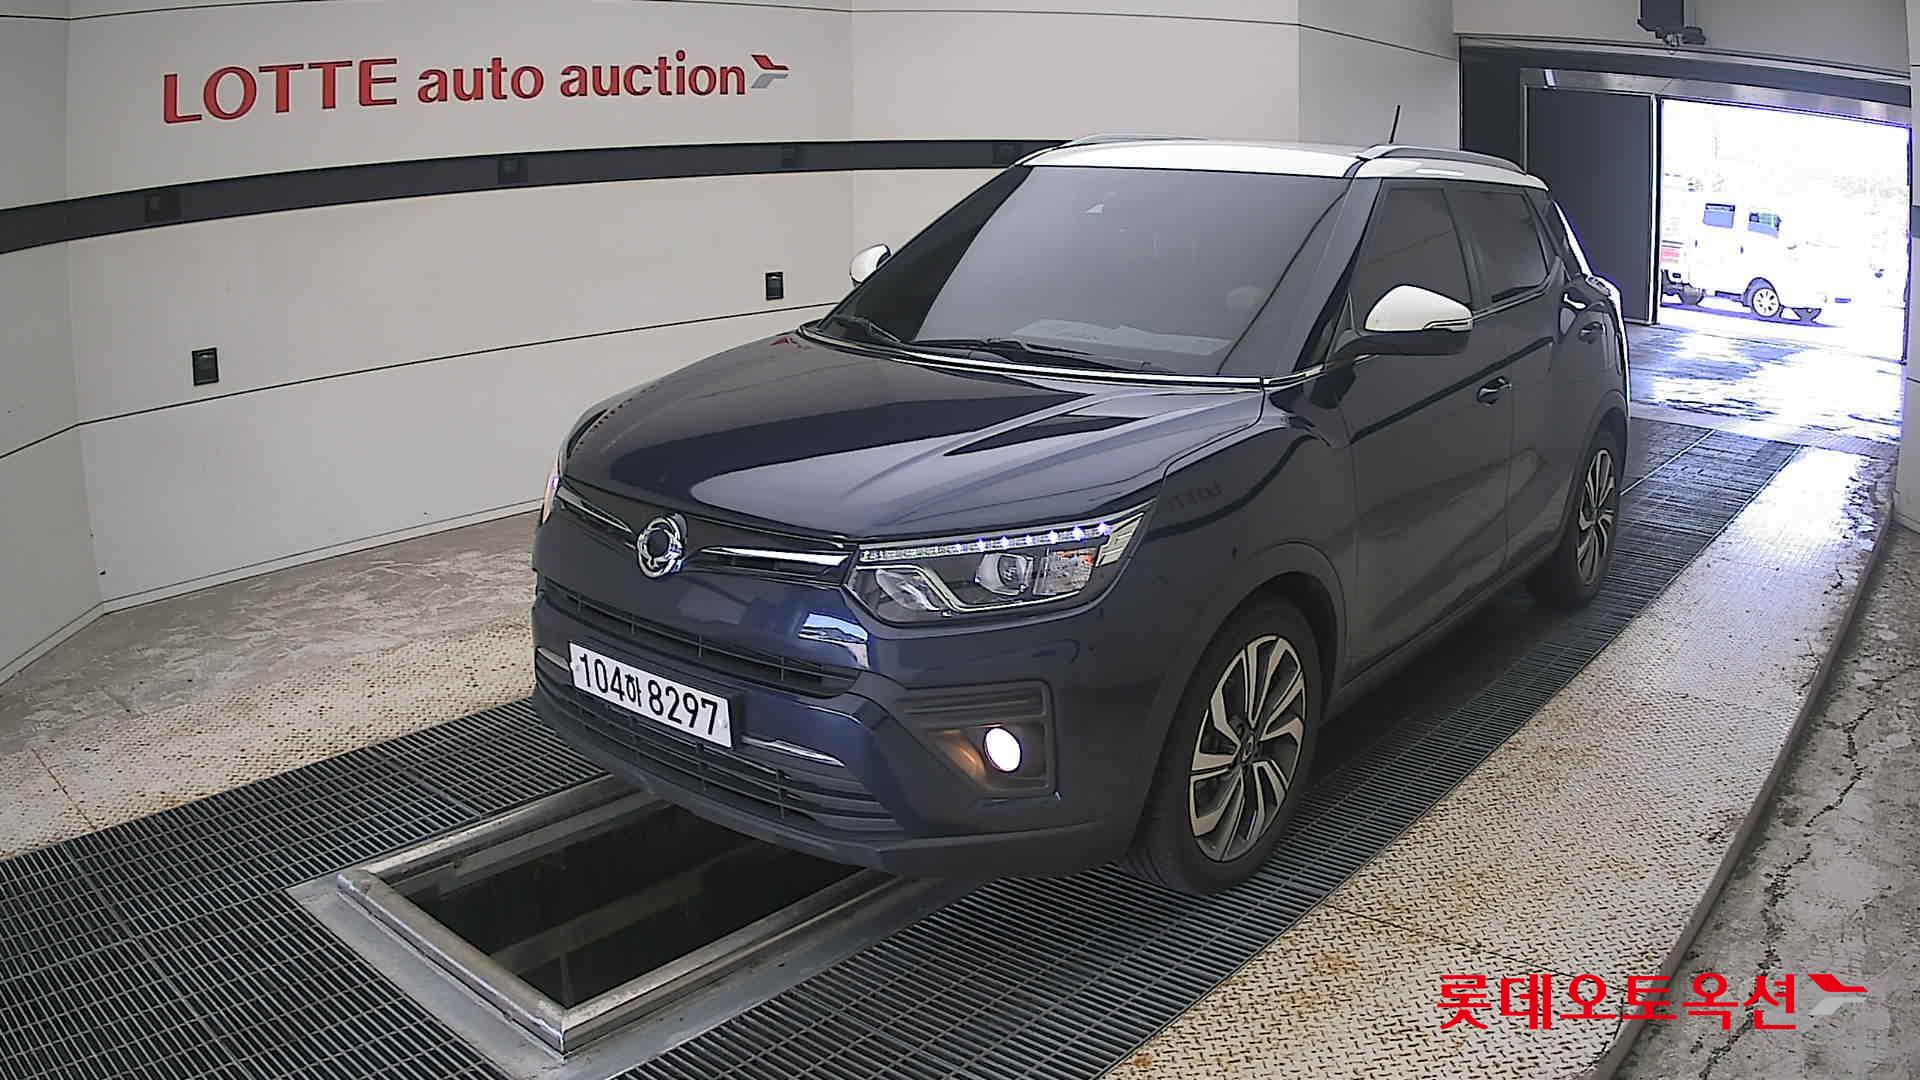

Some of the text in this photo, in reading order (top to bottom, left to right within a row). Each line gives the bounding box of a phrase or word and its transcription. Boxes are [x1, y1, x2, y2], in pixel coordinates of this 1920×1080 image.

[163, 50, 747, 124] LOTTE auto auction
